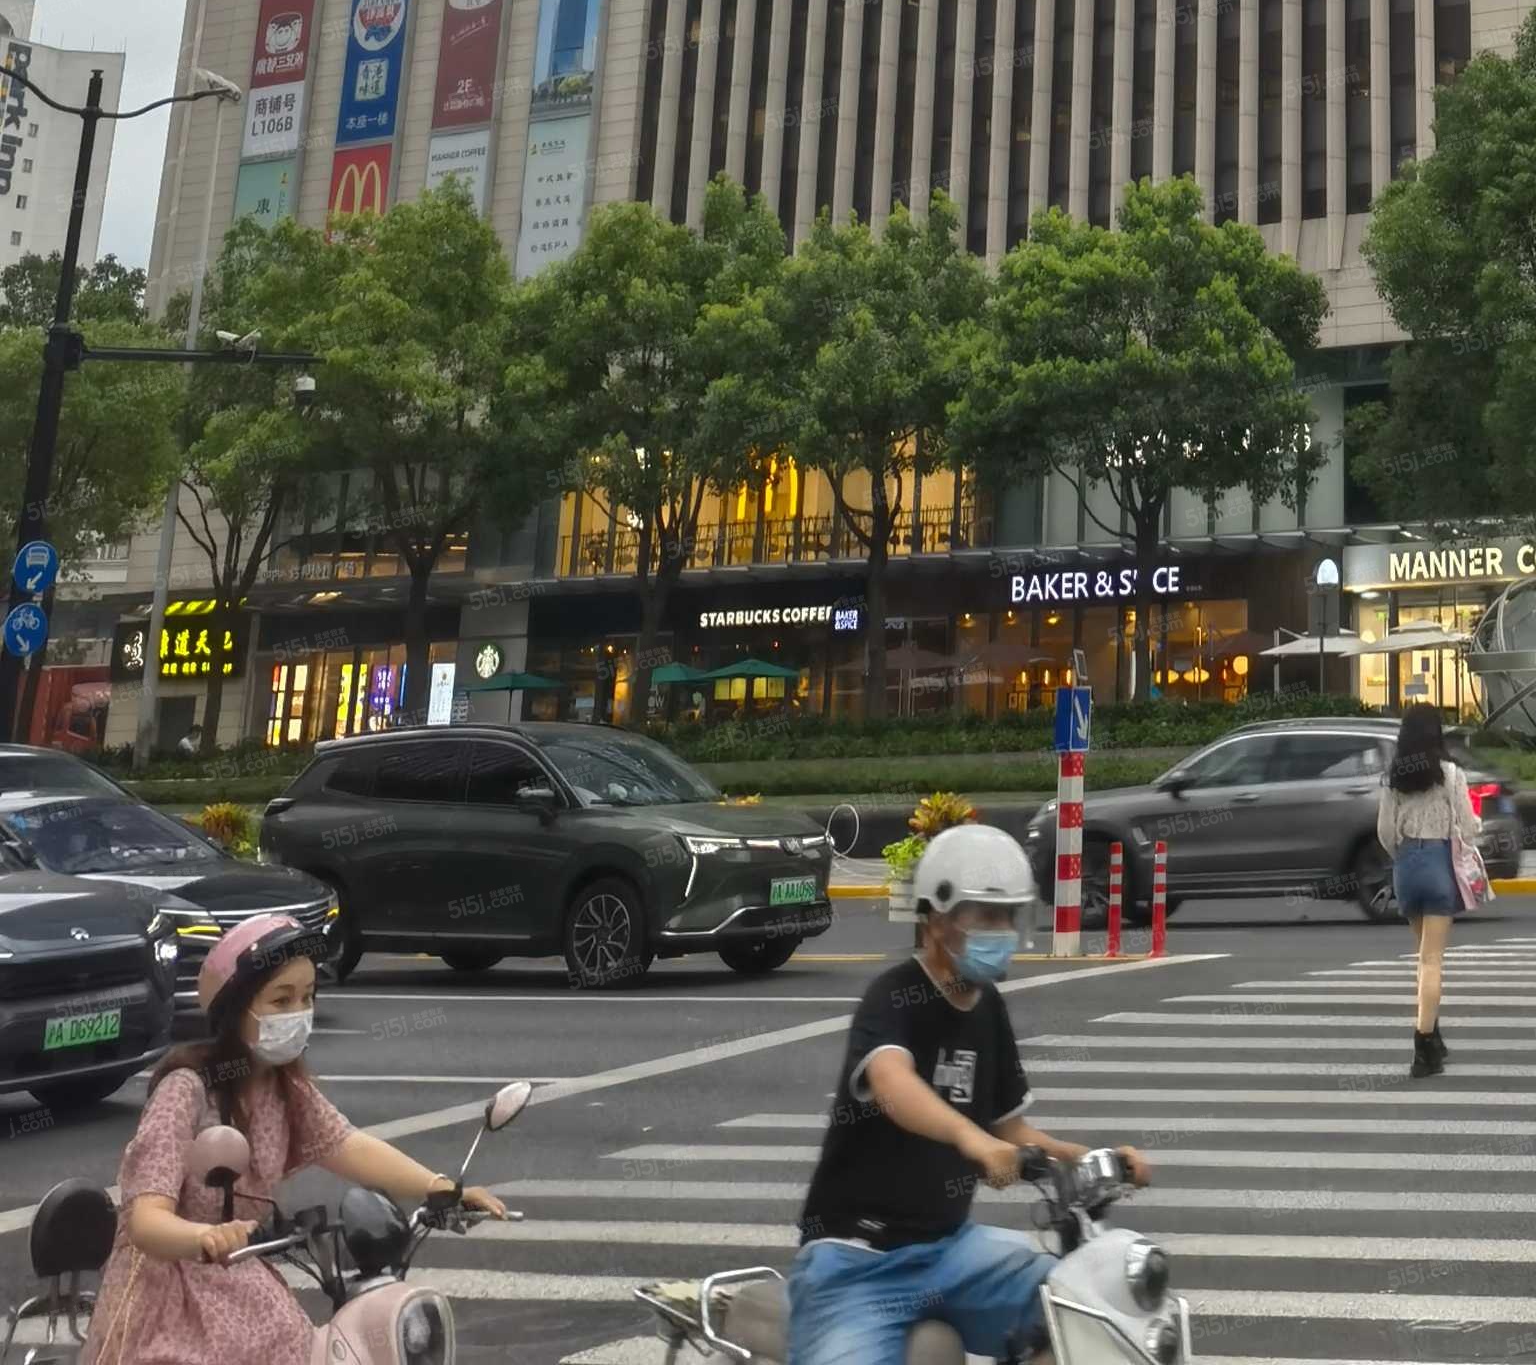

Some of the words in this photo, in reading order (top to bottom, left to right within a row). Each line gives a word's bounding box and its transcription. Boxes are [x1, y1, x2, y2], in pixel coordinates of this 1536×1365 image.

[254, 93, 297, 118] 商铺号
[251, 117, 294, 137] L106B
[1388, 547, 1504, 582] MANNER
[1011, 572, 1089, 603] BAKER
[1094, 571, 1114, 597] &
[1118, 567, 1180, 596] SCE
[699, 609, 781, 628] STARBUCKS
[834, 610, 859, 620] BAKER
